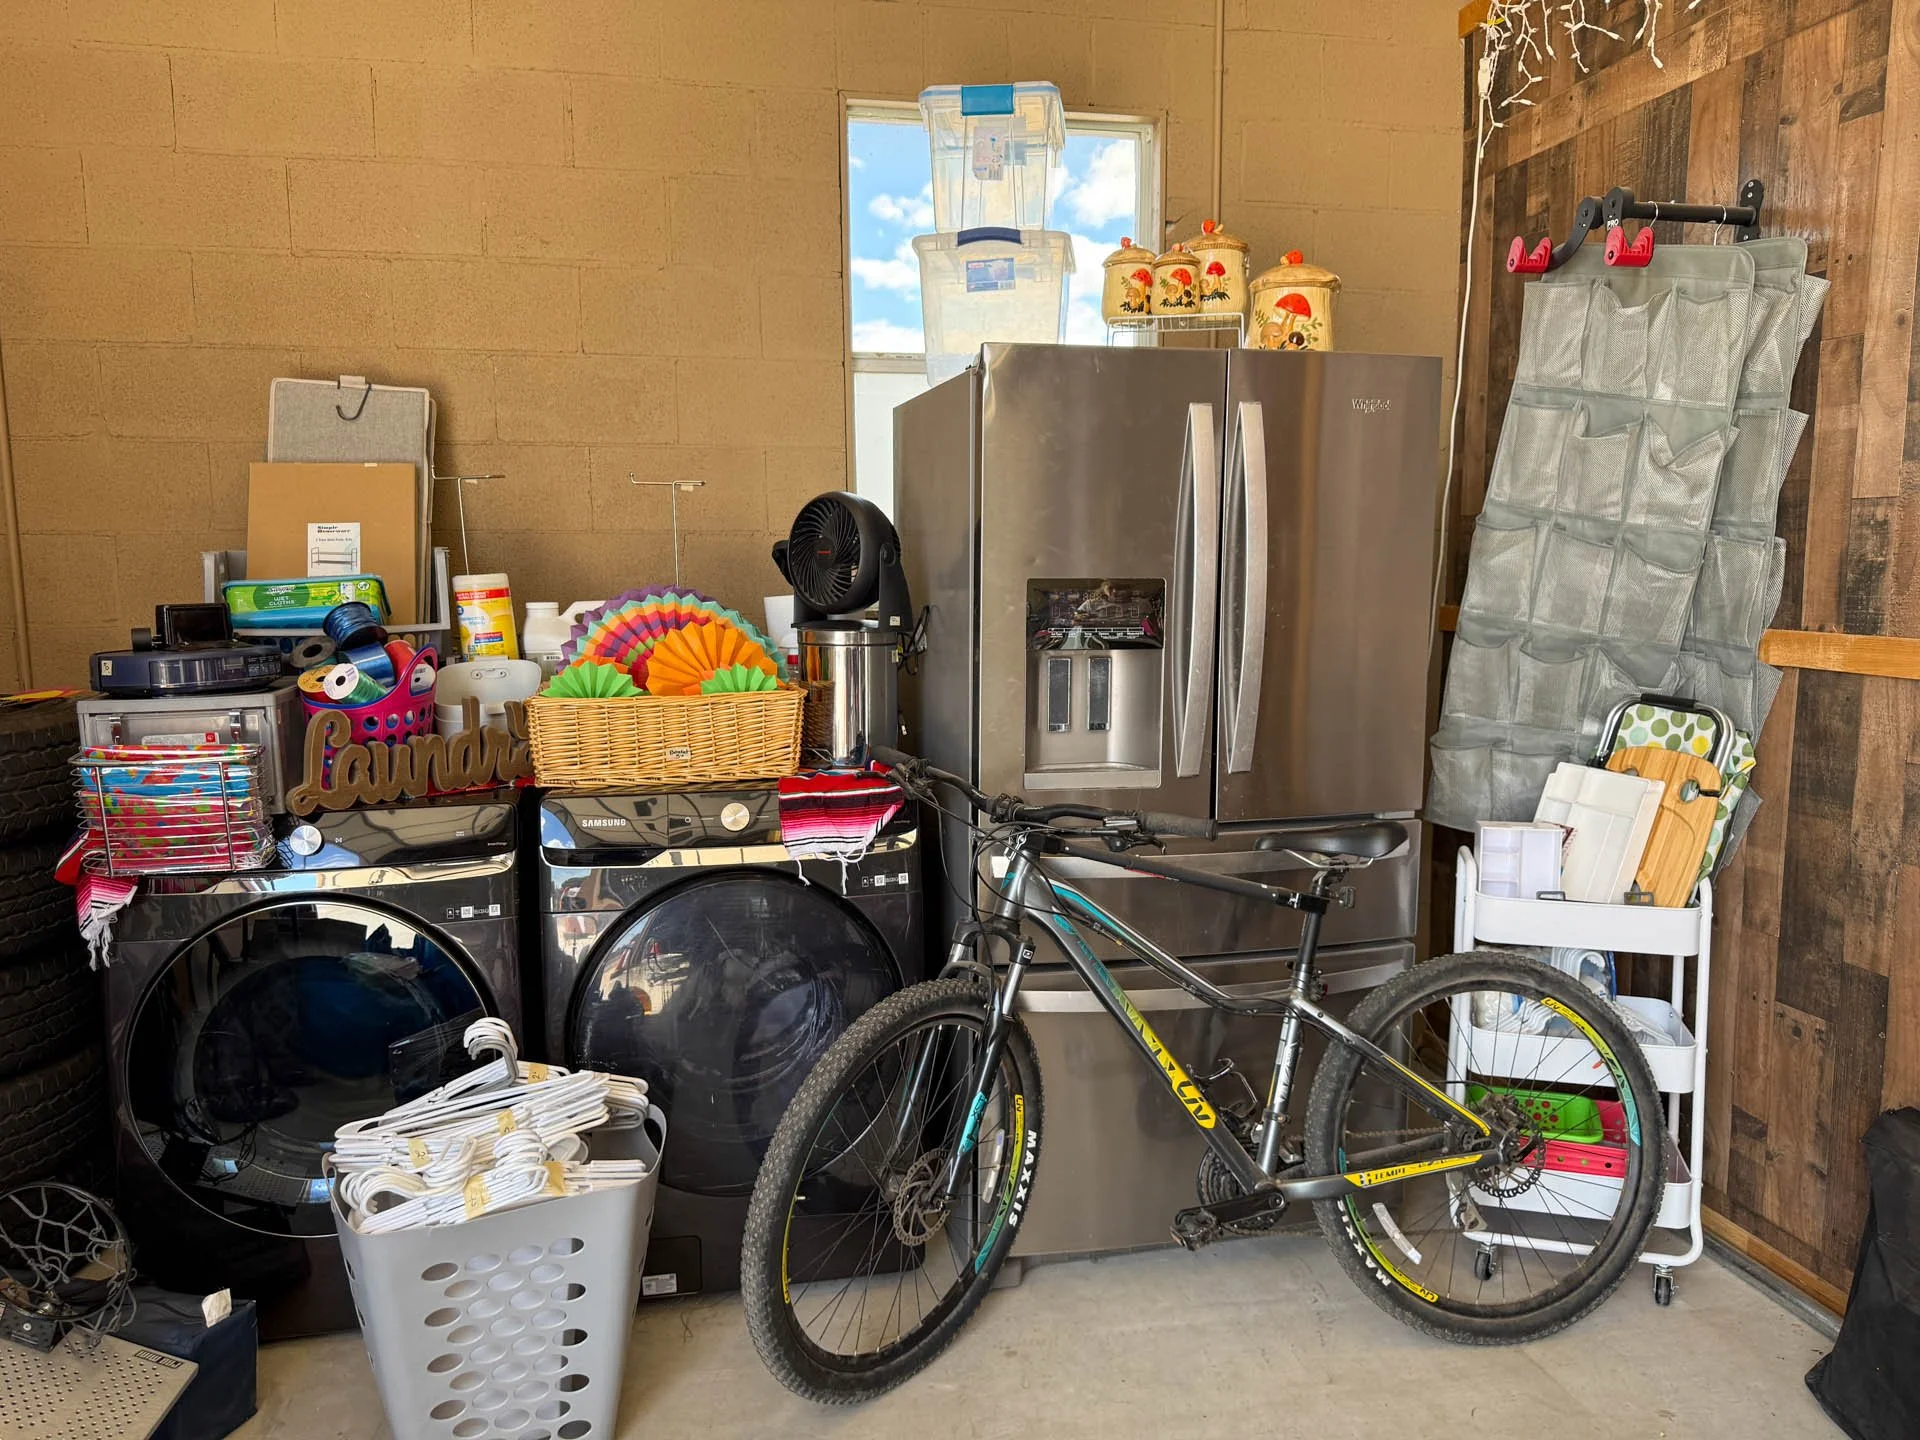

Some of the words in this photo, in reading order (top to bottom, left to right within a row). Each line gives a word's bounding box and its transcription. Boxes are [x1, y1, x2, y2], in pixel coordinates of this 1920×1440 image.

[582, 818, 626, 827] SAMSUNG
[1177, 1080, 1211, 1121] Liv
[1008, 1129, 1038, 1227] MAXXIS
